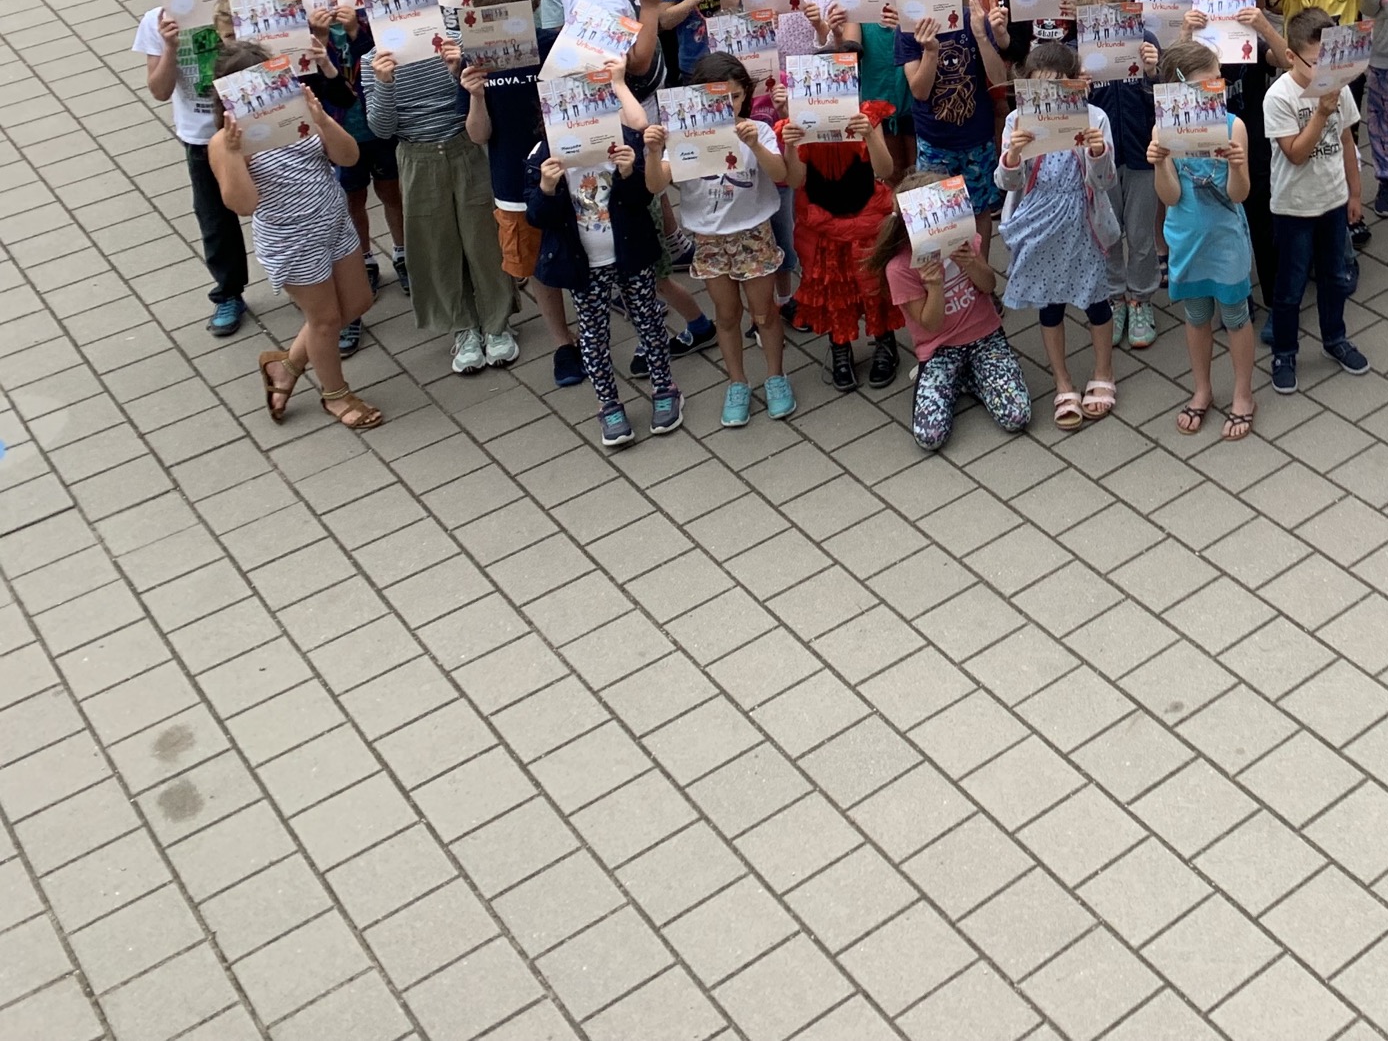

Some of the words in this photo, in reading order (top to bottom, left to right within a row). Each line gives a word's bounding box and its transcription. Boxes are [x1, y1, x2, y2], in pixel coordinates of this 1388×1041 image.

[389, 11, 420, 21] Urkunde
[260, 32, 288, 40] Urkunde
[576, 39, 604, 54] Urkunde
[253, 104, 286, 118] Urkunde
[567, 117, 599, 129] Urkunde
[684, 128, 716, 138] Urkunde
[1177, 126, 1208, 134] Urkunde
[928, 223, 958, 236] Urkunde
